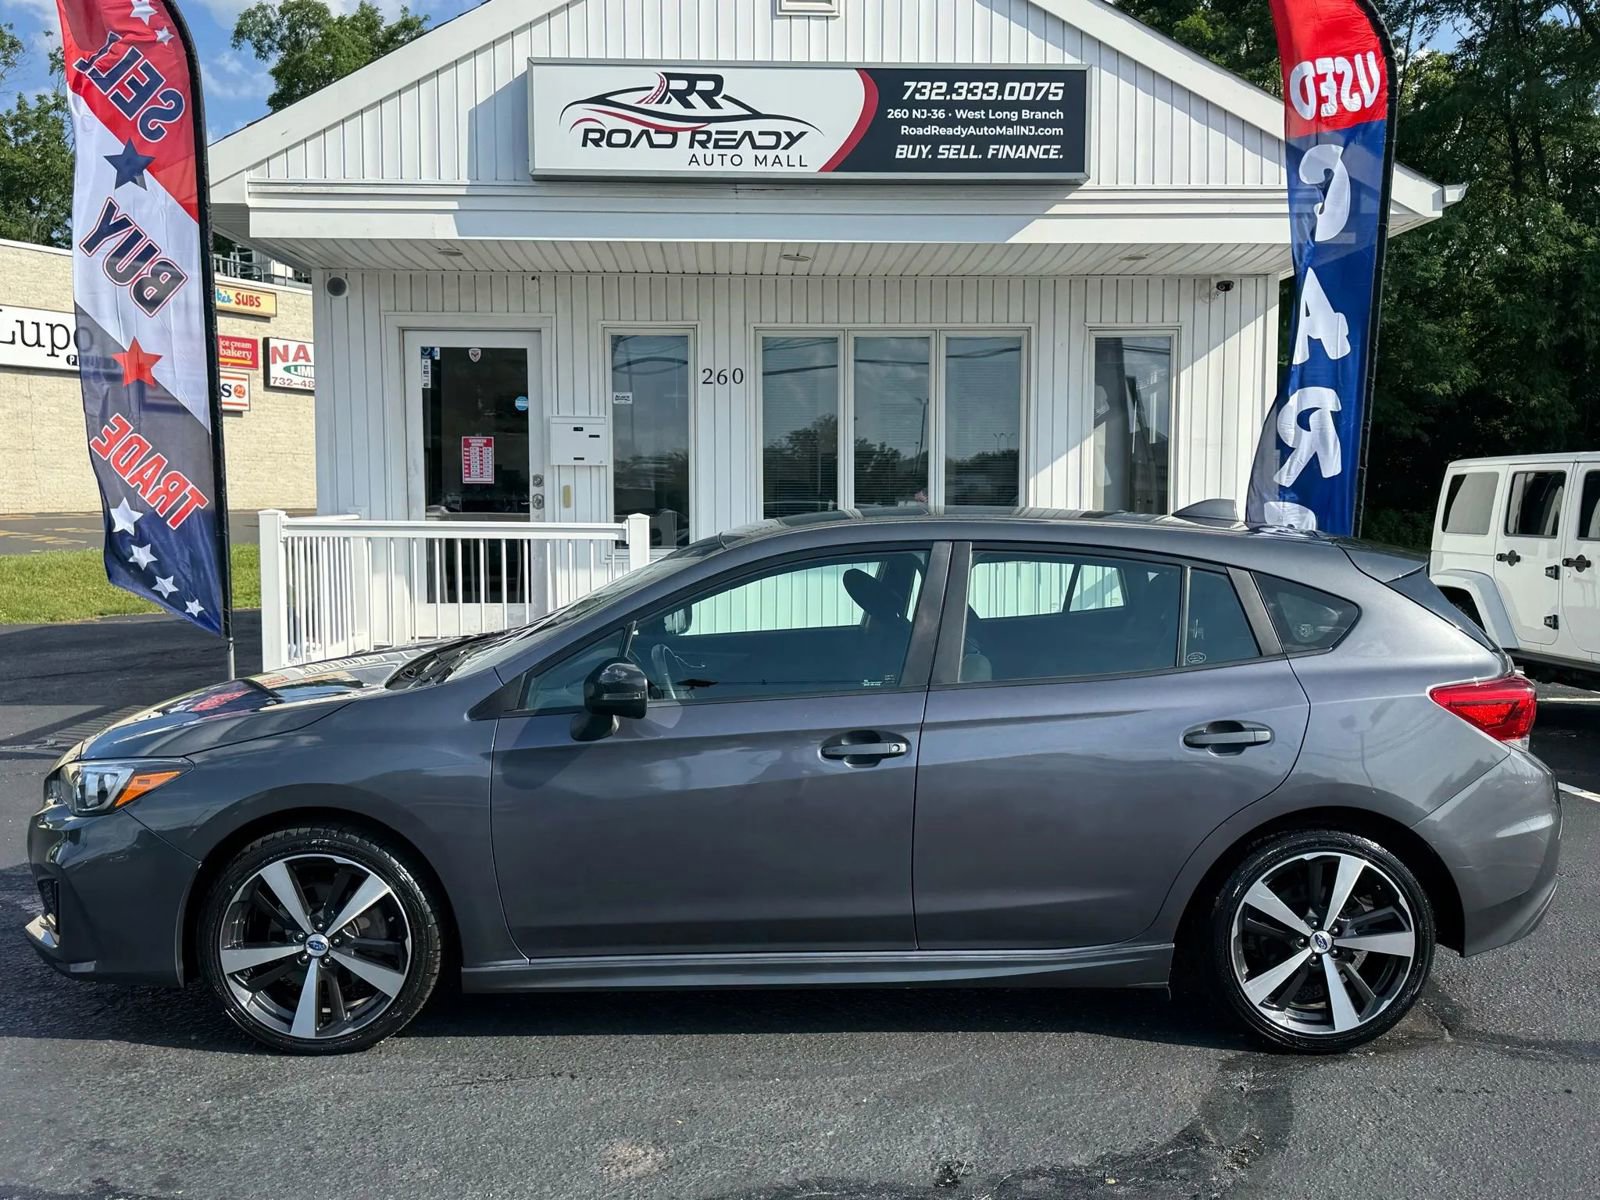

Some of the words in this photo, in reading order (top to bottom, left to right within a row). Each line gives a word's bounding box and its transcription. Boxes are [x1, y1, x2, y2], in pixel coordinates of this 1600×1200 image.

[902, 81, 1065, 101] 732.333.0075
[887, 109, 909, 119] 260
[912, 109, 946, 119] NJ-36
[955, 109, 986, 120] West
[989, 109, 1018, 121] Long
[1021, 109, 1064, 120] Branch
[900, 125, 1064, 138] RoadReadyAutoMallNJ.com
[581, 128, 679, 149] ROAD
[688, 130, 809, 151] READY
[895, 144, 932, 159] BUY.
[937, 144, 982, 159] SELL.
[987, 144, 1064, 159] FINANCE.
[687, 153, 743, 167] AUTO
[754, 154, 808, 168] MALL
[234, 292, 261, 308] SUBS
[230, 340, 252, 349] cream
[219, 345, 253, 360] bakery
[701, 367, 744, 386] 260
